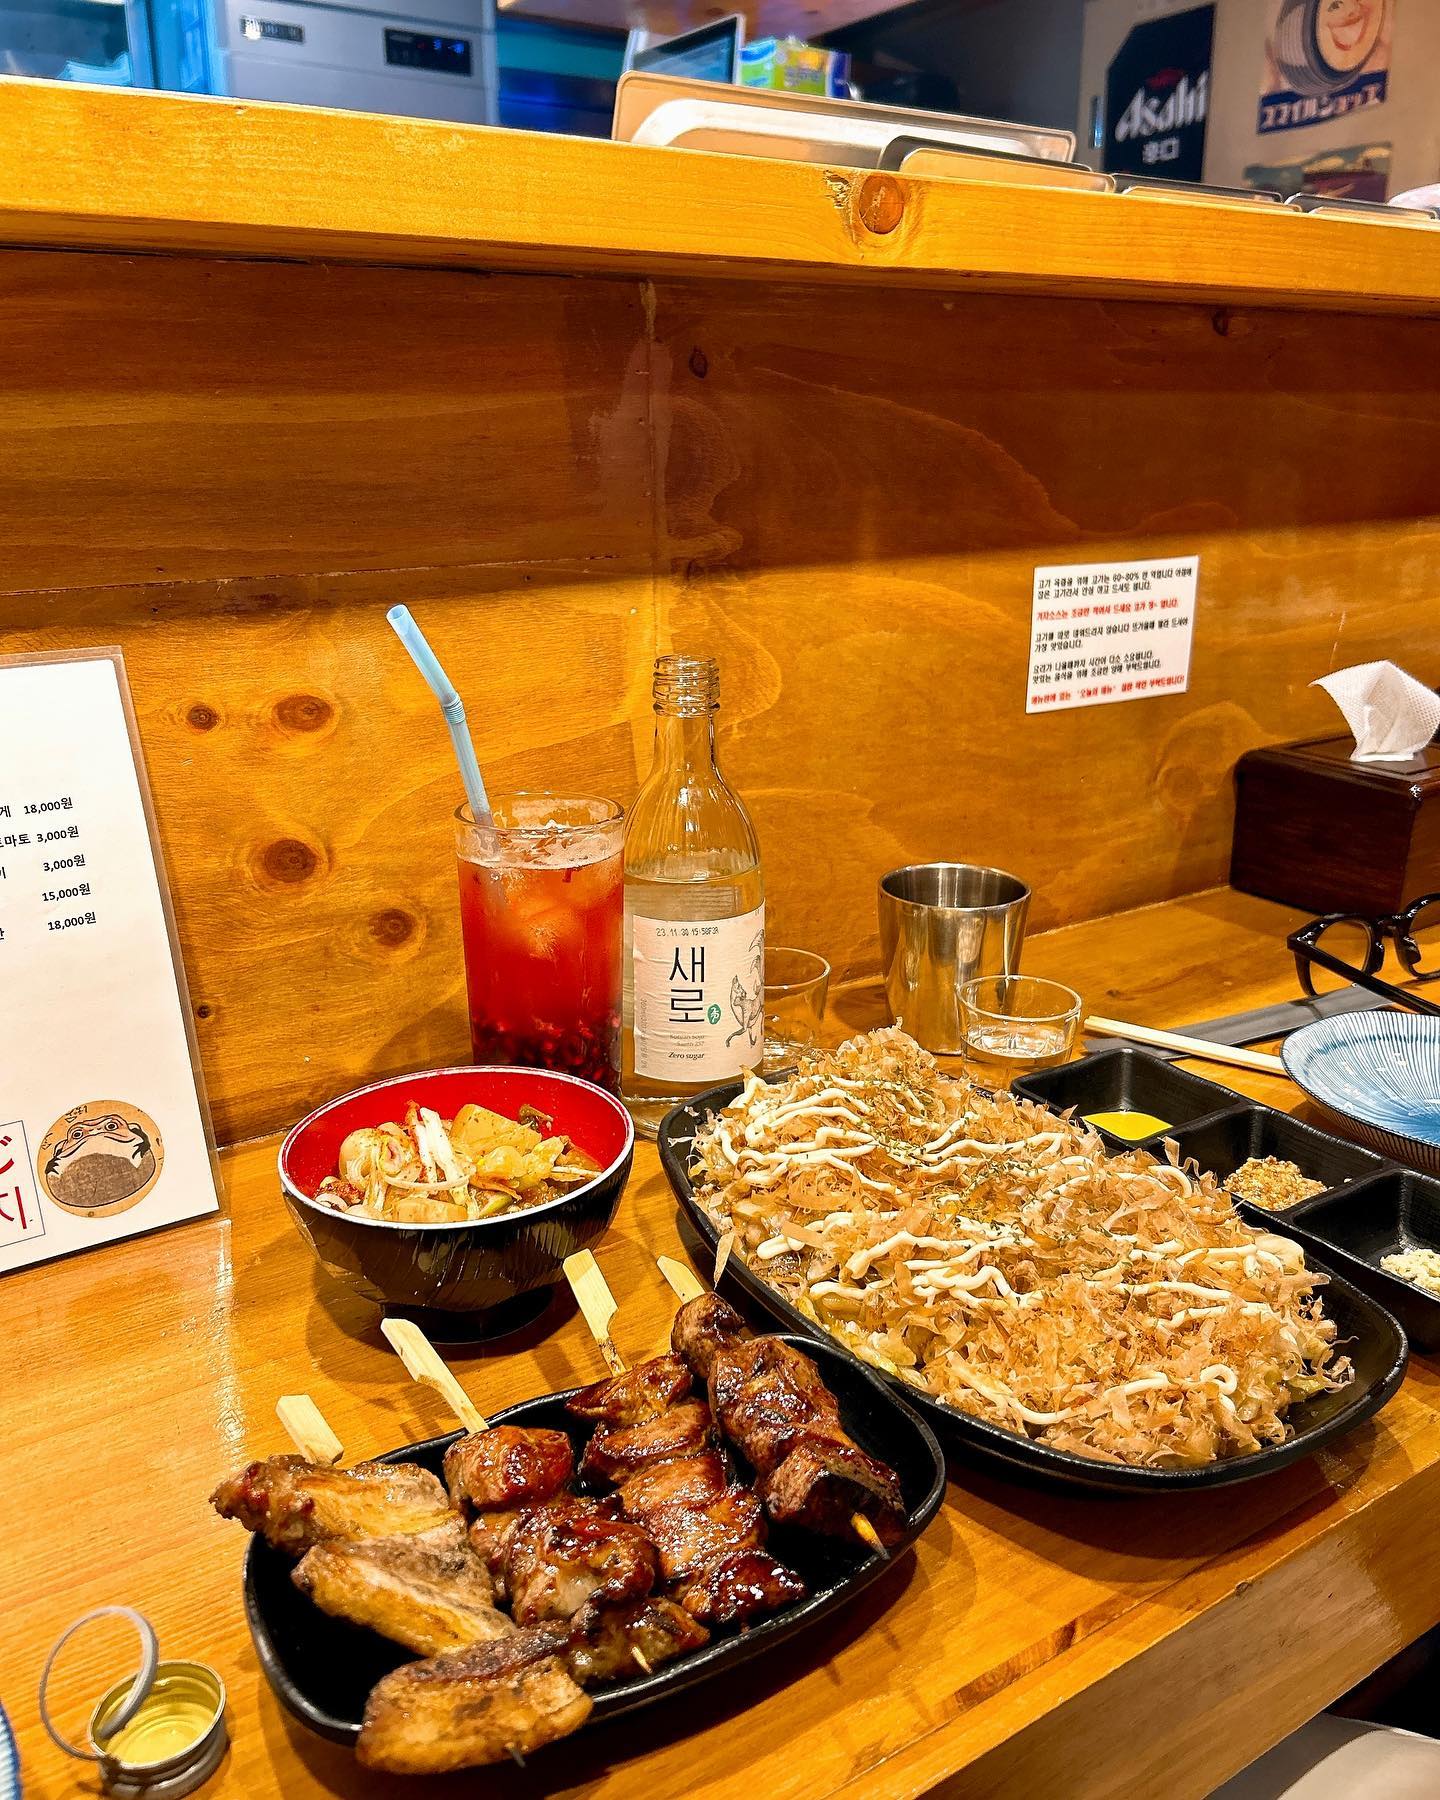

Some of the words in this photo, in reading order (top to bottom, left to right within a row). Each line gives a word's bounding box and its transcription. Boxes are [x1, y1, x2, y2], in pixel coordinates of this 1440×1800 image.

[24, 797, 73, 814] 18,000원
[0, 834, 31, 848] 마토
[37, 825, 80, 844] 3,000원
[43, 854, 86, 872] 3,000원
[42, 883, 91, 902] 15,000원
[48, 911, 97, 931] 18,000원
[669, 946, 705, 1022] 새로
[686, 1052, 705, 1061] sugar
